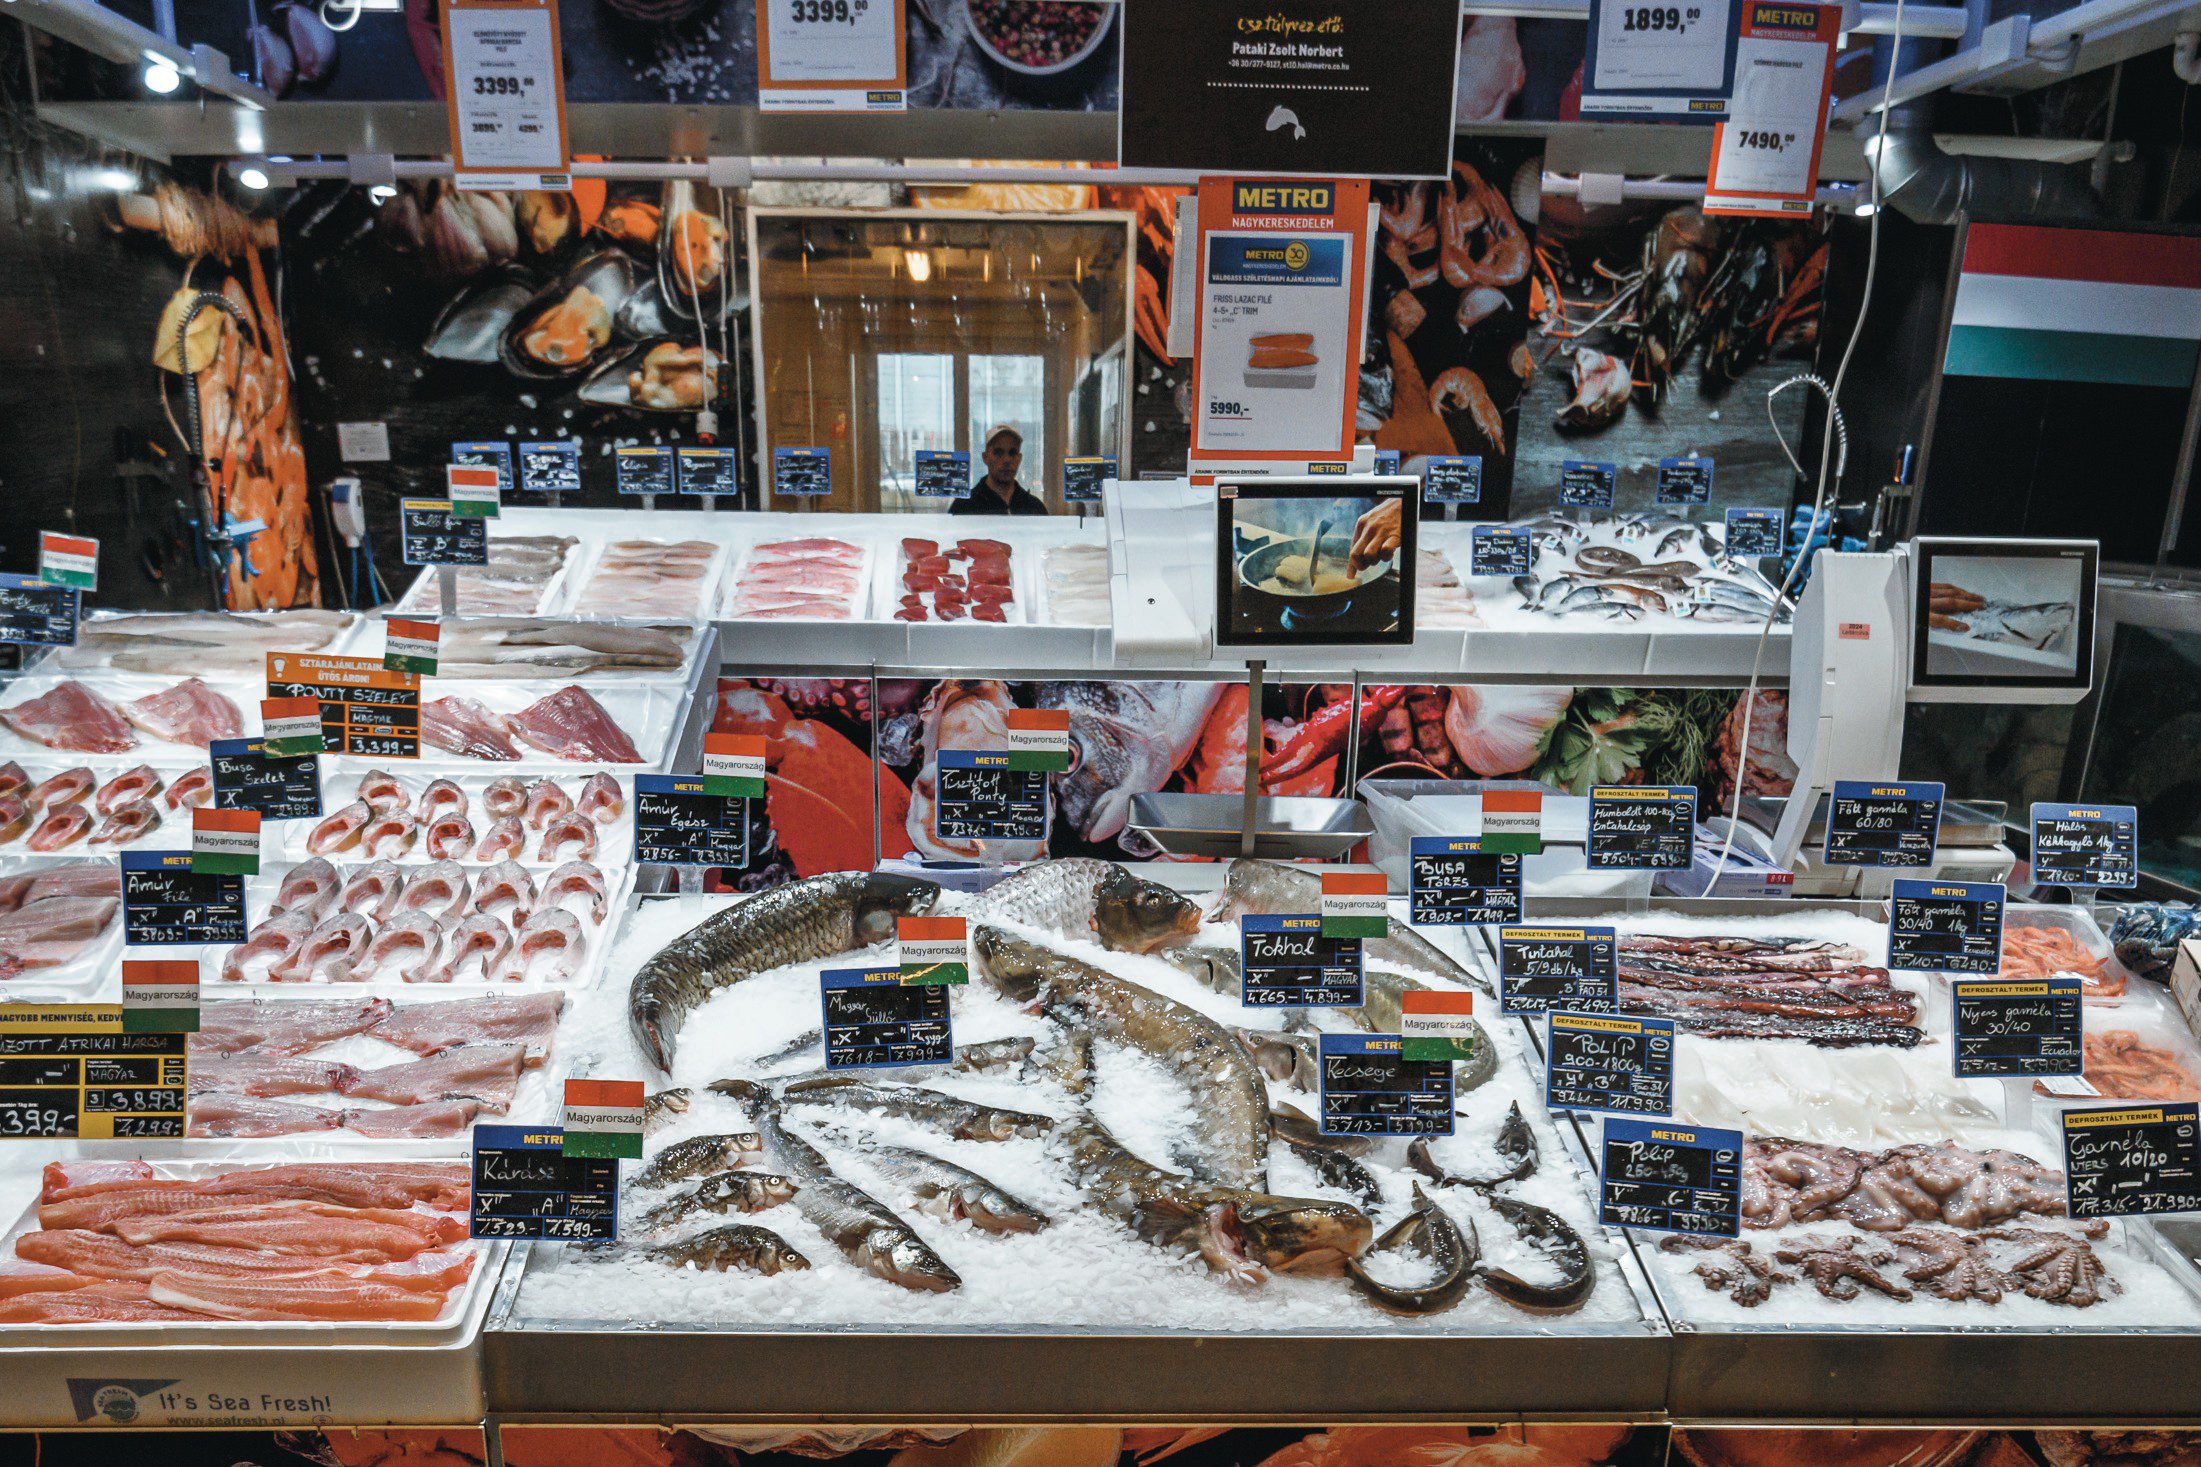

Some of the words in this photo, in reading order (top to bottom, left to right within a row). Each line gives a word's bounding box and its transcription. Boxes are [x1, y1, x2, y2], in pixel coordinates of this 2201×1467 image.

[1756, 9, 1814, 26] METRO
[1232, 42, 1267, 56] Pataki
[1268, 43, 1297, 56] Zsolt
[1298, 44, 1344, 58] Norbert
[868, 93, 901, 102] METRO
[1690, 102, 1723, 111] METRO
[1238, 187, 1329, 209] METRO
[1232, 217, 1334, 230] NAGYKERESKEDELEM
[1245, 249, 1284, 260] METRO
[1213, 294, 1233, 304] FRISS
[1234, 294, 1256, 304] LAZAC
[1256, 293, 1272, 304] FILÉ
[1242, 307, 1259, 316] TRIM
[1210, 401, 1249, 417] 5990,-
[1309, 465, 1345, 474] METRO
[387, 639, 438, 654] Magyarország
[286, 683, 346, 702] PONTY
[353, 688, 415, 704] SZELET
[264, 721, 320, 733] Magyarország
[1010, 734, 1067, 745] Magyarország
[218, 761, 255, 774] Busa
[706, 759, 764, 771] Magyarország
[243, 771, 286, 786] Szelet
[970, 785, 1007, 806] Ponty
[1871, 787, 1906, 796] METRO
[639, 798, 679, 815] Amúr
[1594, 805, 1642, 820] Humboldt
[1838, 803, 1861, 815] Főtt
[2068, 809, 2101, 819] METRO
[670, 811, 710, 832] Egész
[1483, 817, 1540, 827] Magyarország
[1855, 817, 1893, 829] 60/80
[195, 835, 260, 849] Magyarország
[1414, 860, 1466, 875] BUSA
[128, 873, 174, 894] Amúr
[1423, 876, 1470, 888] TÖRZS
[1931, 887, 1967, 897] METRO
[1324, 900, 1387, 911] Magyarország
[1282, 919, 1321, 928] METRO
[1898, 918, 1933, 931] 30/40
[1947, 919, 1968, 938] 1kg
[901, 946, 967, 957] Magyarország
[1252, 936, 1315, 957] Tokhal
[1963, 945, 1996, 956] Ecuador
[125, 990, 199, 1001] Magyarország
[1961, 986, 2013, 994] DEFROSZTÁLT
[829, 995, 867, 1014] Magyar
[40, 1011, 96, 1024] MENNYISÉG,
[1404, 1019, 1472, 1030] Magyarország
[1556, 1017, 1607, 1028] DEFROSZTÁLT
[1608, 1021, 1638, 1030] TERMÉK
[1643, 1027, 1673, 1037] METRO
[1985, 1021, 2031, 1035] 30/40
[57, 1037, 116, 1052] AFRIKAI
[122, 1037, 169, 1049] HARCSA
[1572, 1034, 1636, 1056] POLIP
[2040, 1042, 2082, 1055] Ecuador
[90, 1068, 138, 1081] MAGYAR
[1326, 1059, 1396, 1083] Kecsege
[89, 1093, 99, 1104] 3
[566, 1112, 643, 1126] Magyarország
[2068, 1114, 2124, 1124] DEFROSZTÁLT
[2125, 1112, 2159, 1121] TERMÉK
[2165, 1113, 2197, 1123] METRO
[1650, 1129, 1697, 1144] METRO
[1628, 1141, 1675, 1164] Polip
[2119, 1149, 2168, 1168] 10/20
[159, 1392, 198, 1411] It's
[207, 1393, 251, 1411] Sea
[261, 1393, 333, 1413] Fresh!
